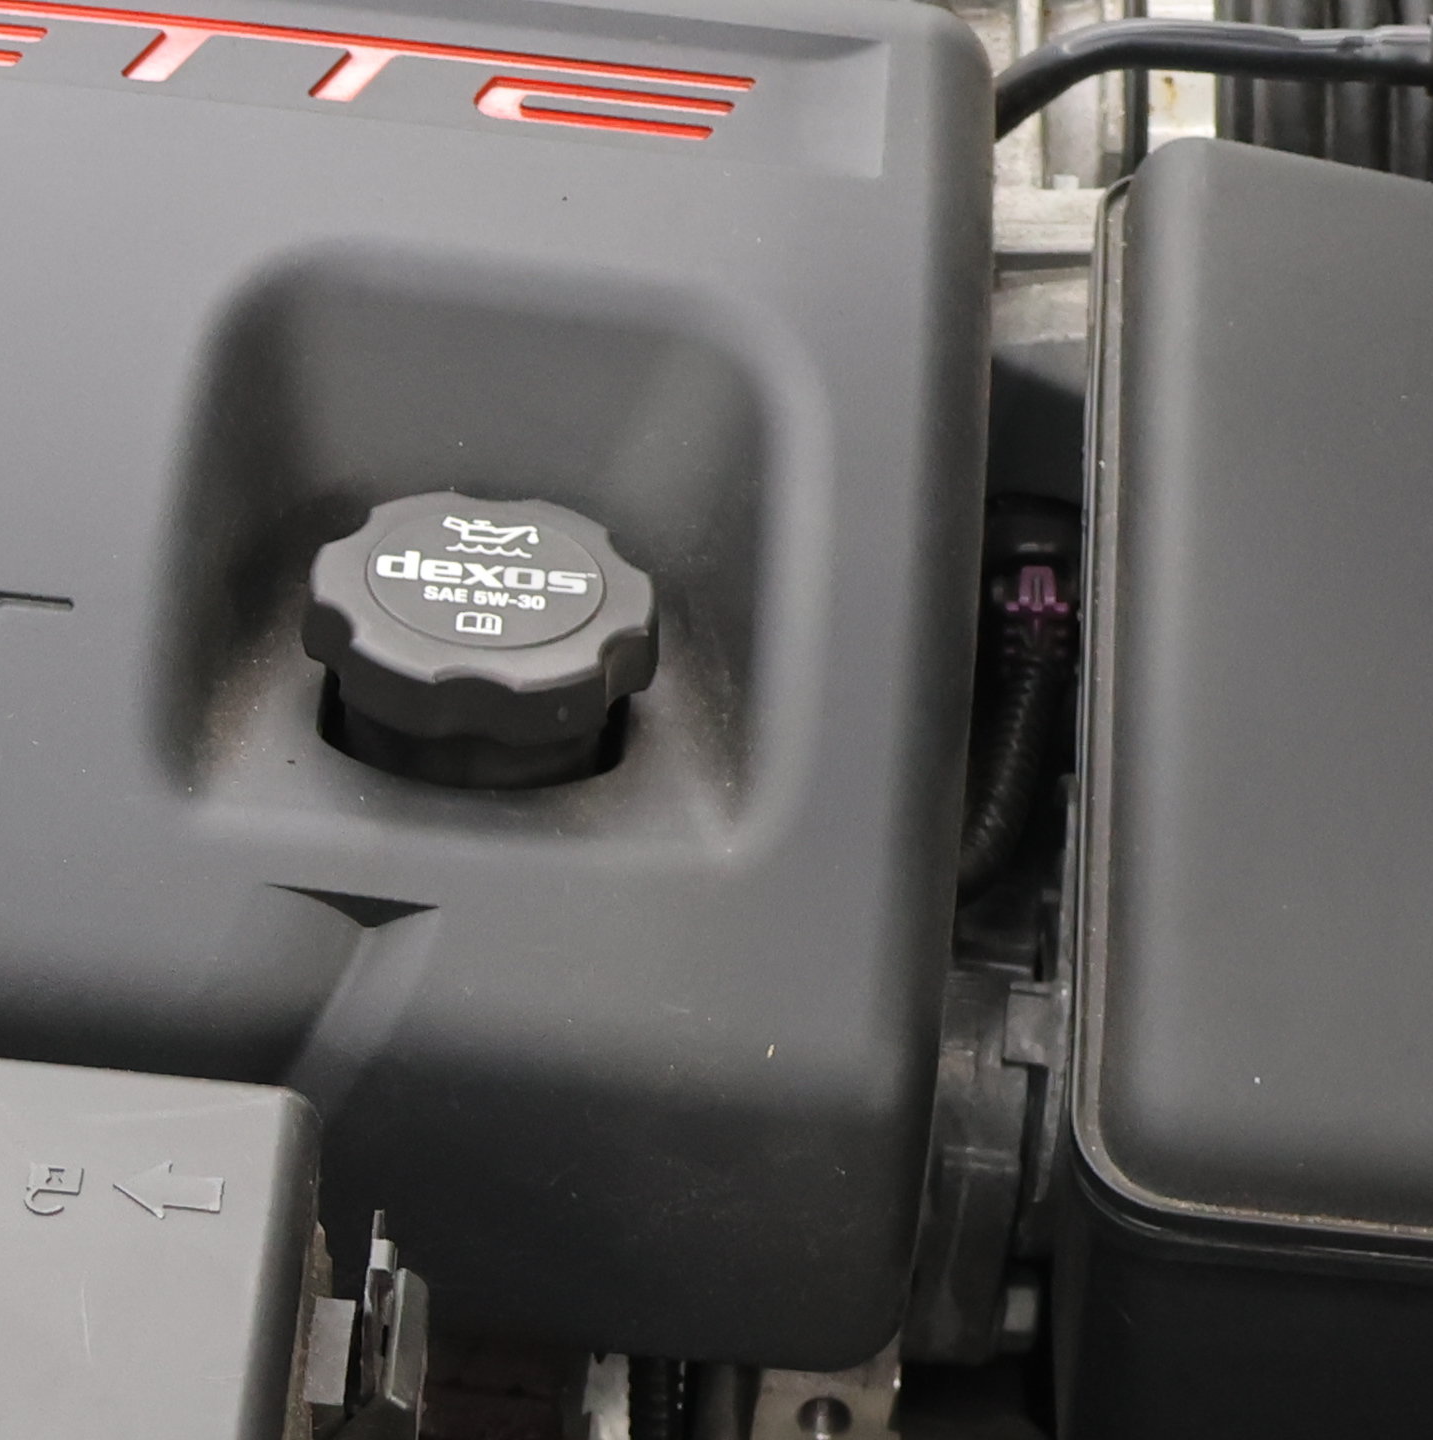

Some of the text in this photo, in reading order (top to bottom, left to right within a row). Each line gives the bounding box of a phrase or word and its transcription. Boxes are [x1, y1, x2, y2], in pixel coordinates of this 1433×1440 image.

[376, 550, 589, 594] dexos
[423, 585, 546, 610] SAE 5W-30
